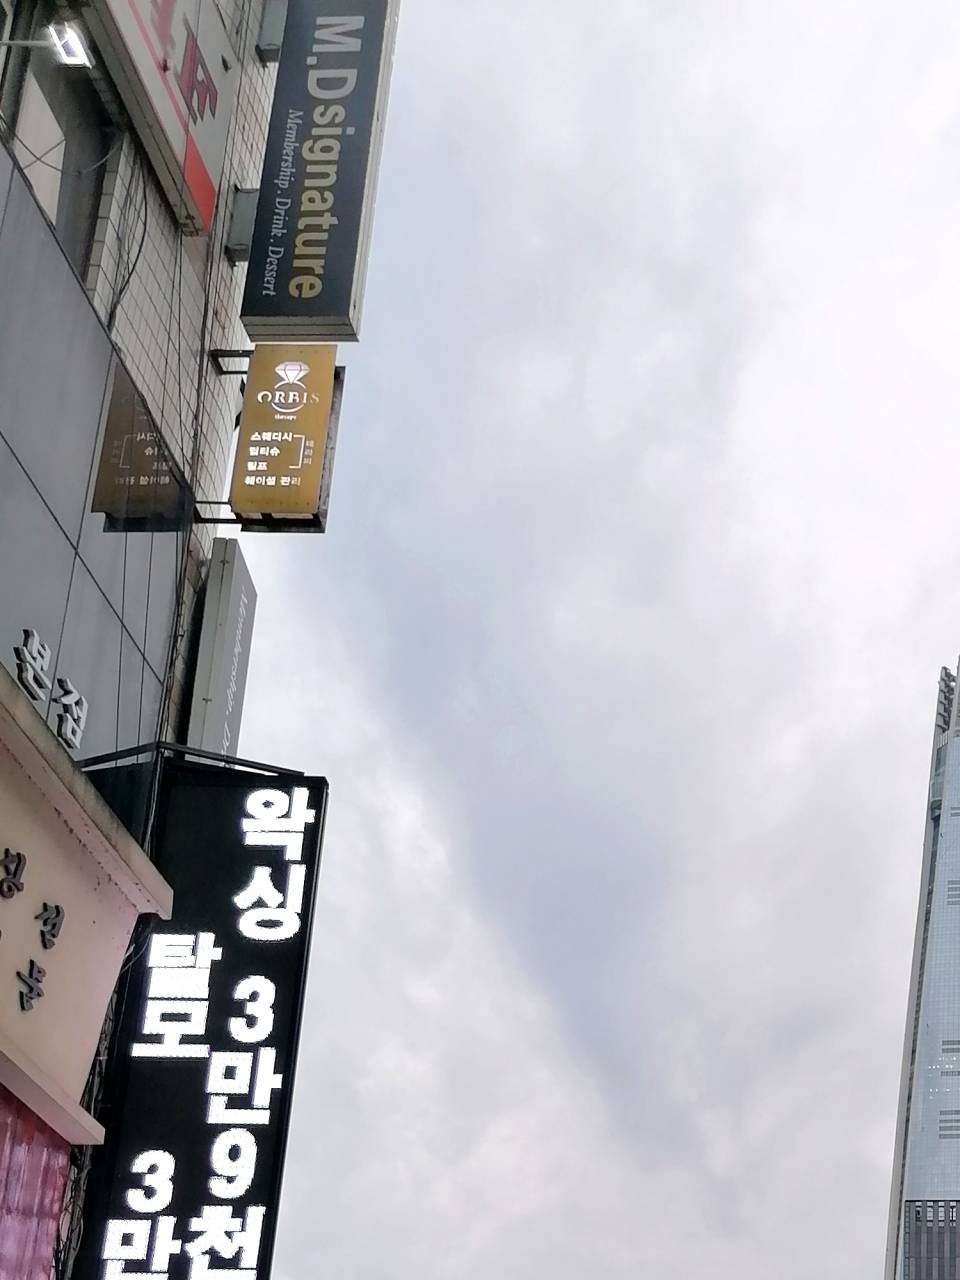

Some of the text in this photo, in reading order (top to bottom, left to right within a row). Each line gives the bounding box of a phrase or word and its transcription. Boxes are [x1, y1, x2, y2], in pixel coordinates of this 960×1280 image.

[289, 14, 366, 300] M.Dsignature
[232, 786, 316, 942] 왁싱
[131, 930, 223, 1061] 탈모
